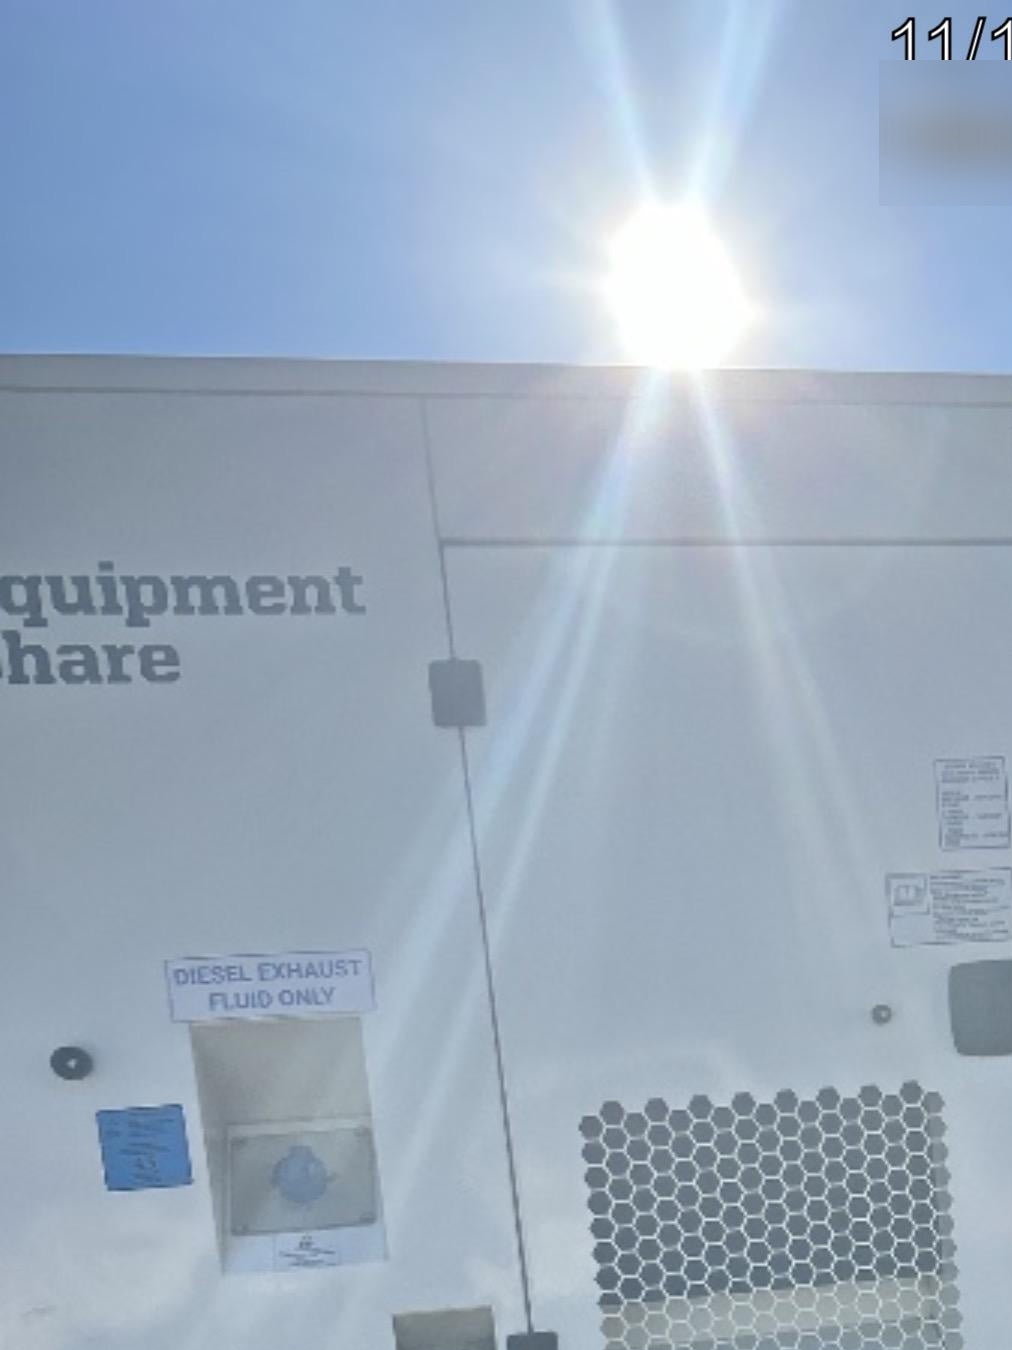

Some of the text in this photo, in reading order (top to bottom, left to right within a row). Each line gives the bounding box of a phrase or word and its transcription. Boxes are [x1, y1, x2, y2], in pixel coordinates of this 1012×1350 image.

[0, 561, 367, 627] quipment
[0, 630, 181, 684] hare
[173, 959, 362, 985] DIESEL EXHAUST
[208, 986, 335, 1011] FLUID ONLY
